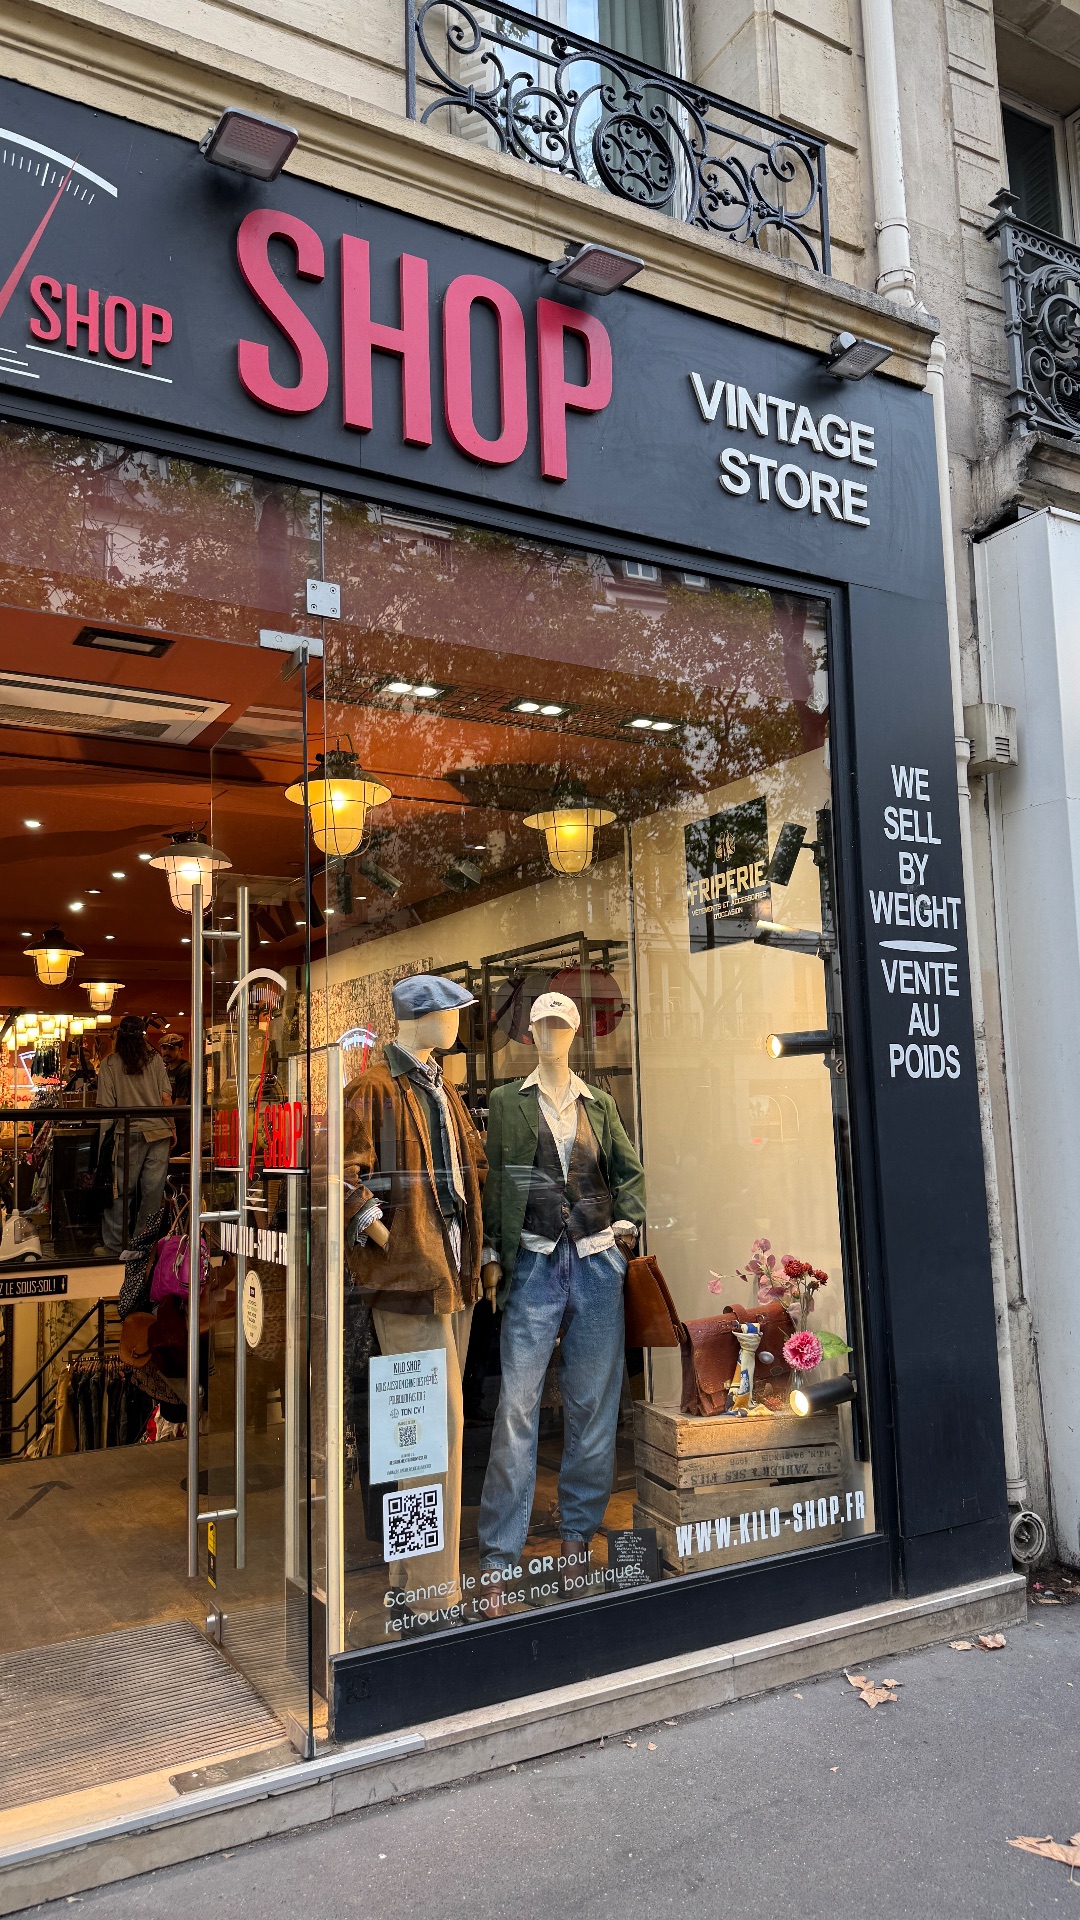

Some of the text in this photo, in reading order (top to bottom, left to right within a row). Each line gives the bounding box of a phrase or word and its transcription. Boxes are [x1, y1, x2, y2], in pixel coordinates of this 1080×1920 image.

[29, 274, 173, 367] SHOP
[237, 208, 613, 483] SHOP
[689, 371, 879, 468] VINTAGE
[719, 447, 871, 527] STORE
[890, 764, 930, 802] WE
[883, 808, 942, 845] SELL
[690, 860, 767, 906] FRIPERIE
[899, 851, 929, 886] BY
[722, 900, 730, 909] ET
[869, 890, 961, 930] WEIGHT
[880, 958, 960, 997] VENTE
[908, 1002, 940, 1037] AU
[889, 1043, 961, 1079] POIDS
[263, 1101, 303, 1169] SHOP
[5, 1281, 14, 1296] LE
[393, 1359, 421, 1374] KILO SHOP
[690, 1472, 718, 1487] FILS
[725, 1469, 747, 1483] SES
[675, 1490, 866, 1558] WWW.KILO-SHOP.FR
[384, 1549, 594, 1609] Scannez le code QR pour
[385, 1602, 467, 1634] retrouver
[472, 1590, 526, 1613] toutes
[530, 1580, 559, 1600] nos
[564, 1561, 645, 1593] boutiques,
